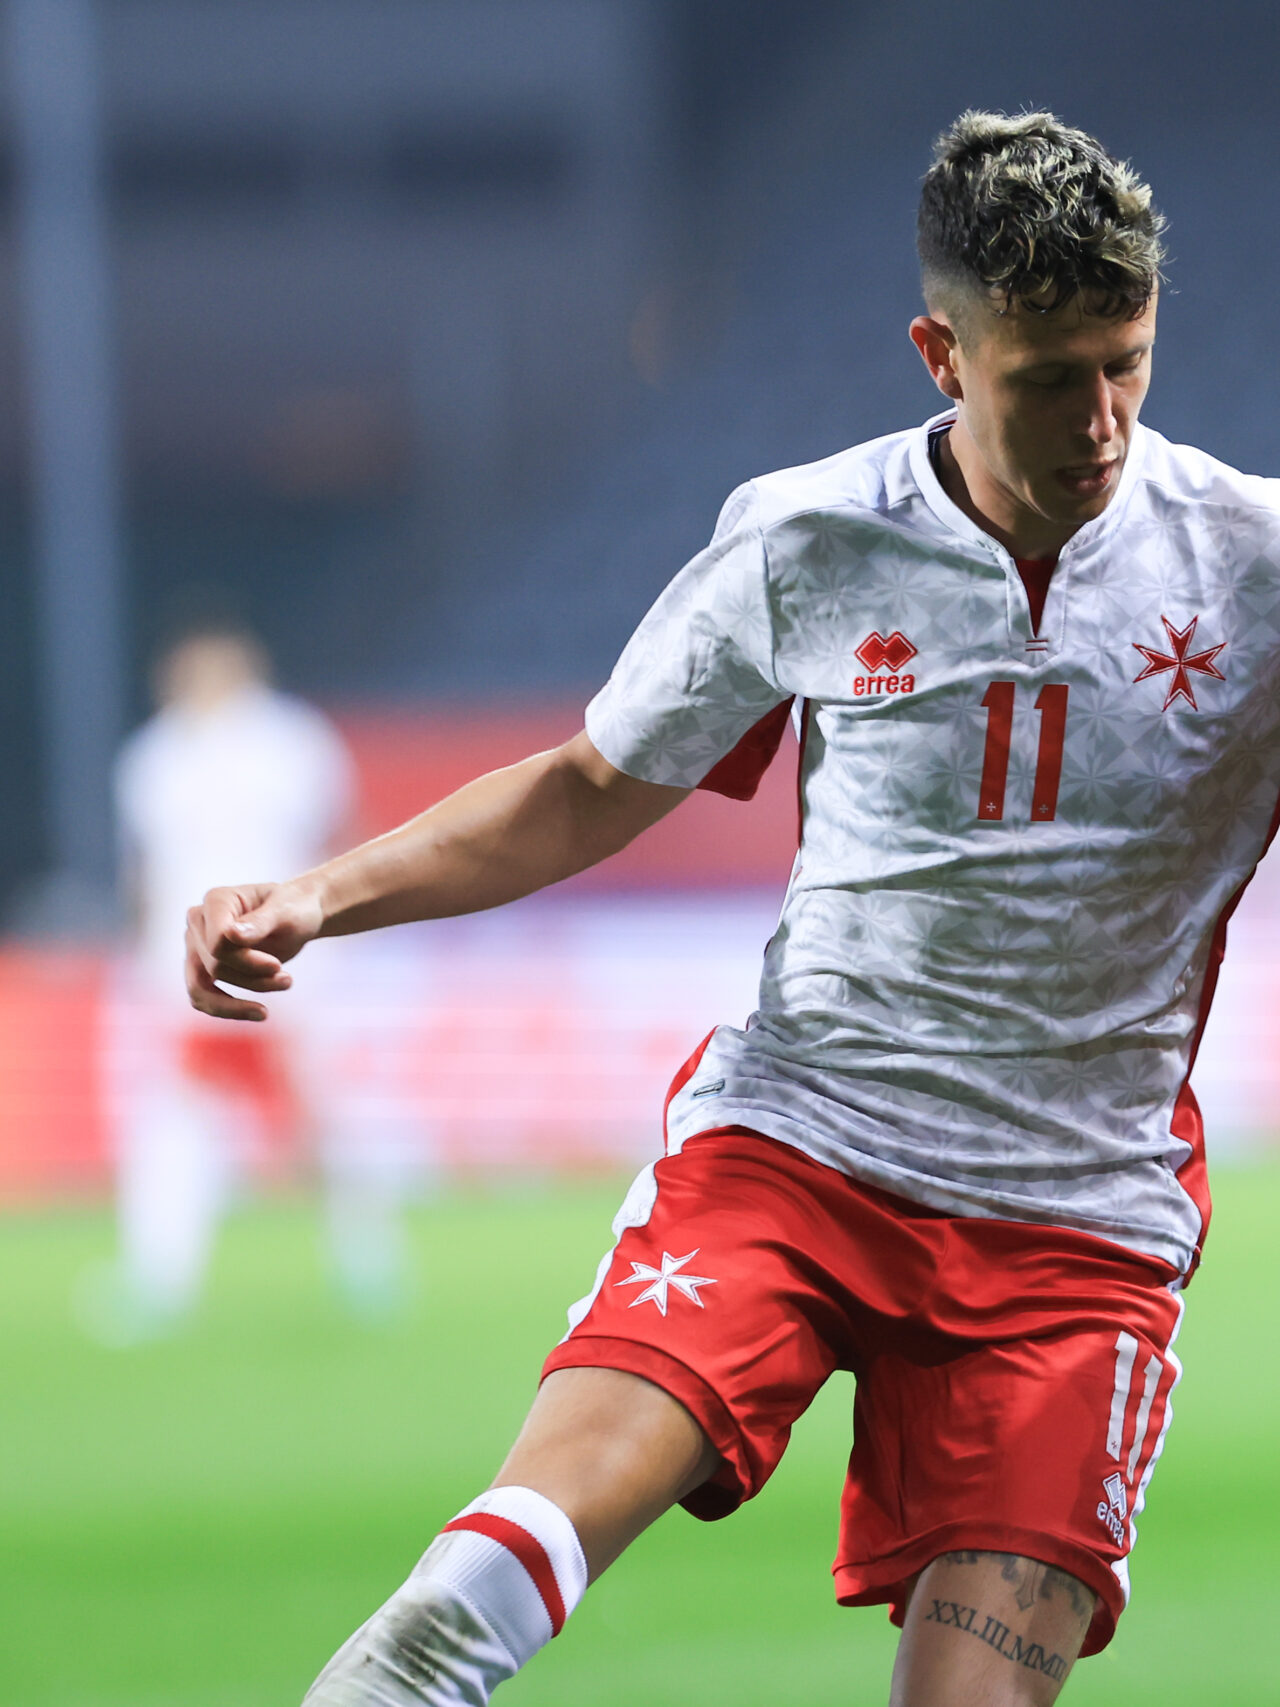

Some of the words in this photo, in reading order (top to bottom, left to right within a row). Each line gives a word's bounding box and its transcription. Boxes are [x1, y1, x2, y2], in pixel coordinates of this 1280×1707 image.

[853, 674, 915, 696] errea
[977, 681, 1070, 822] 11
[1106, 1330, 1164, 1485] 11
